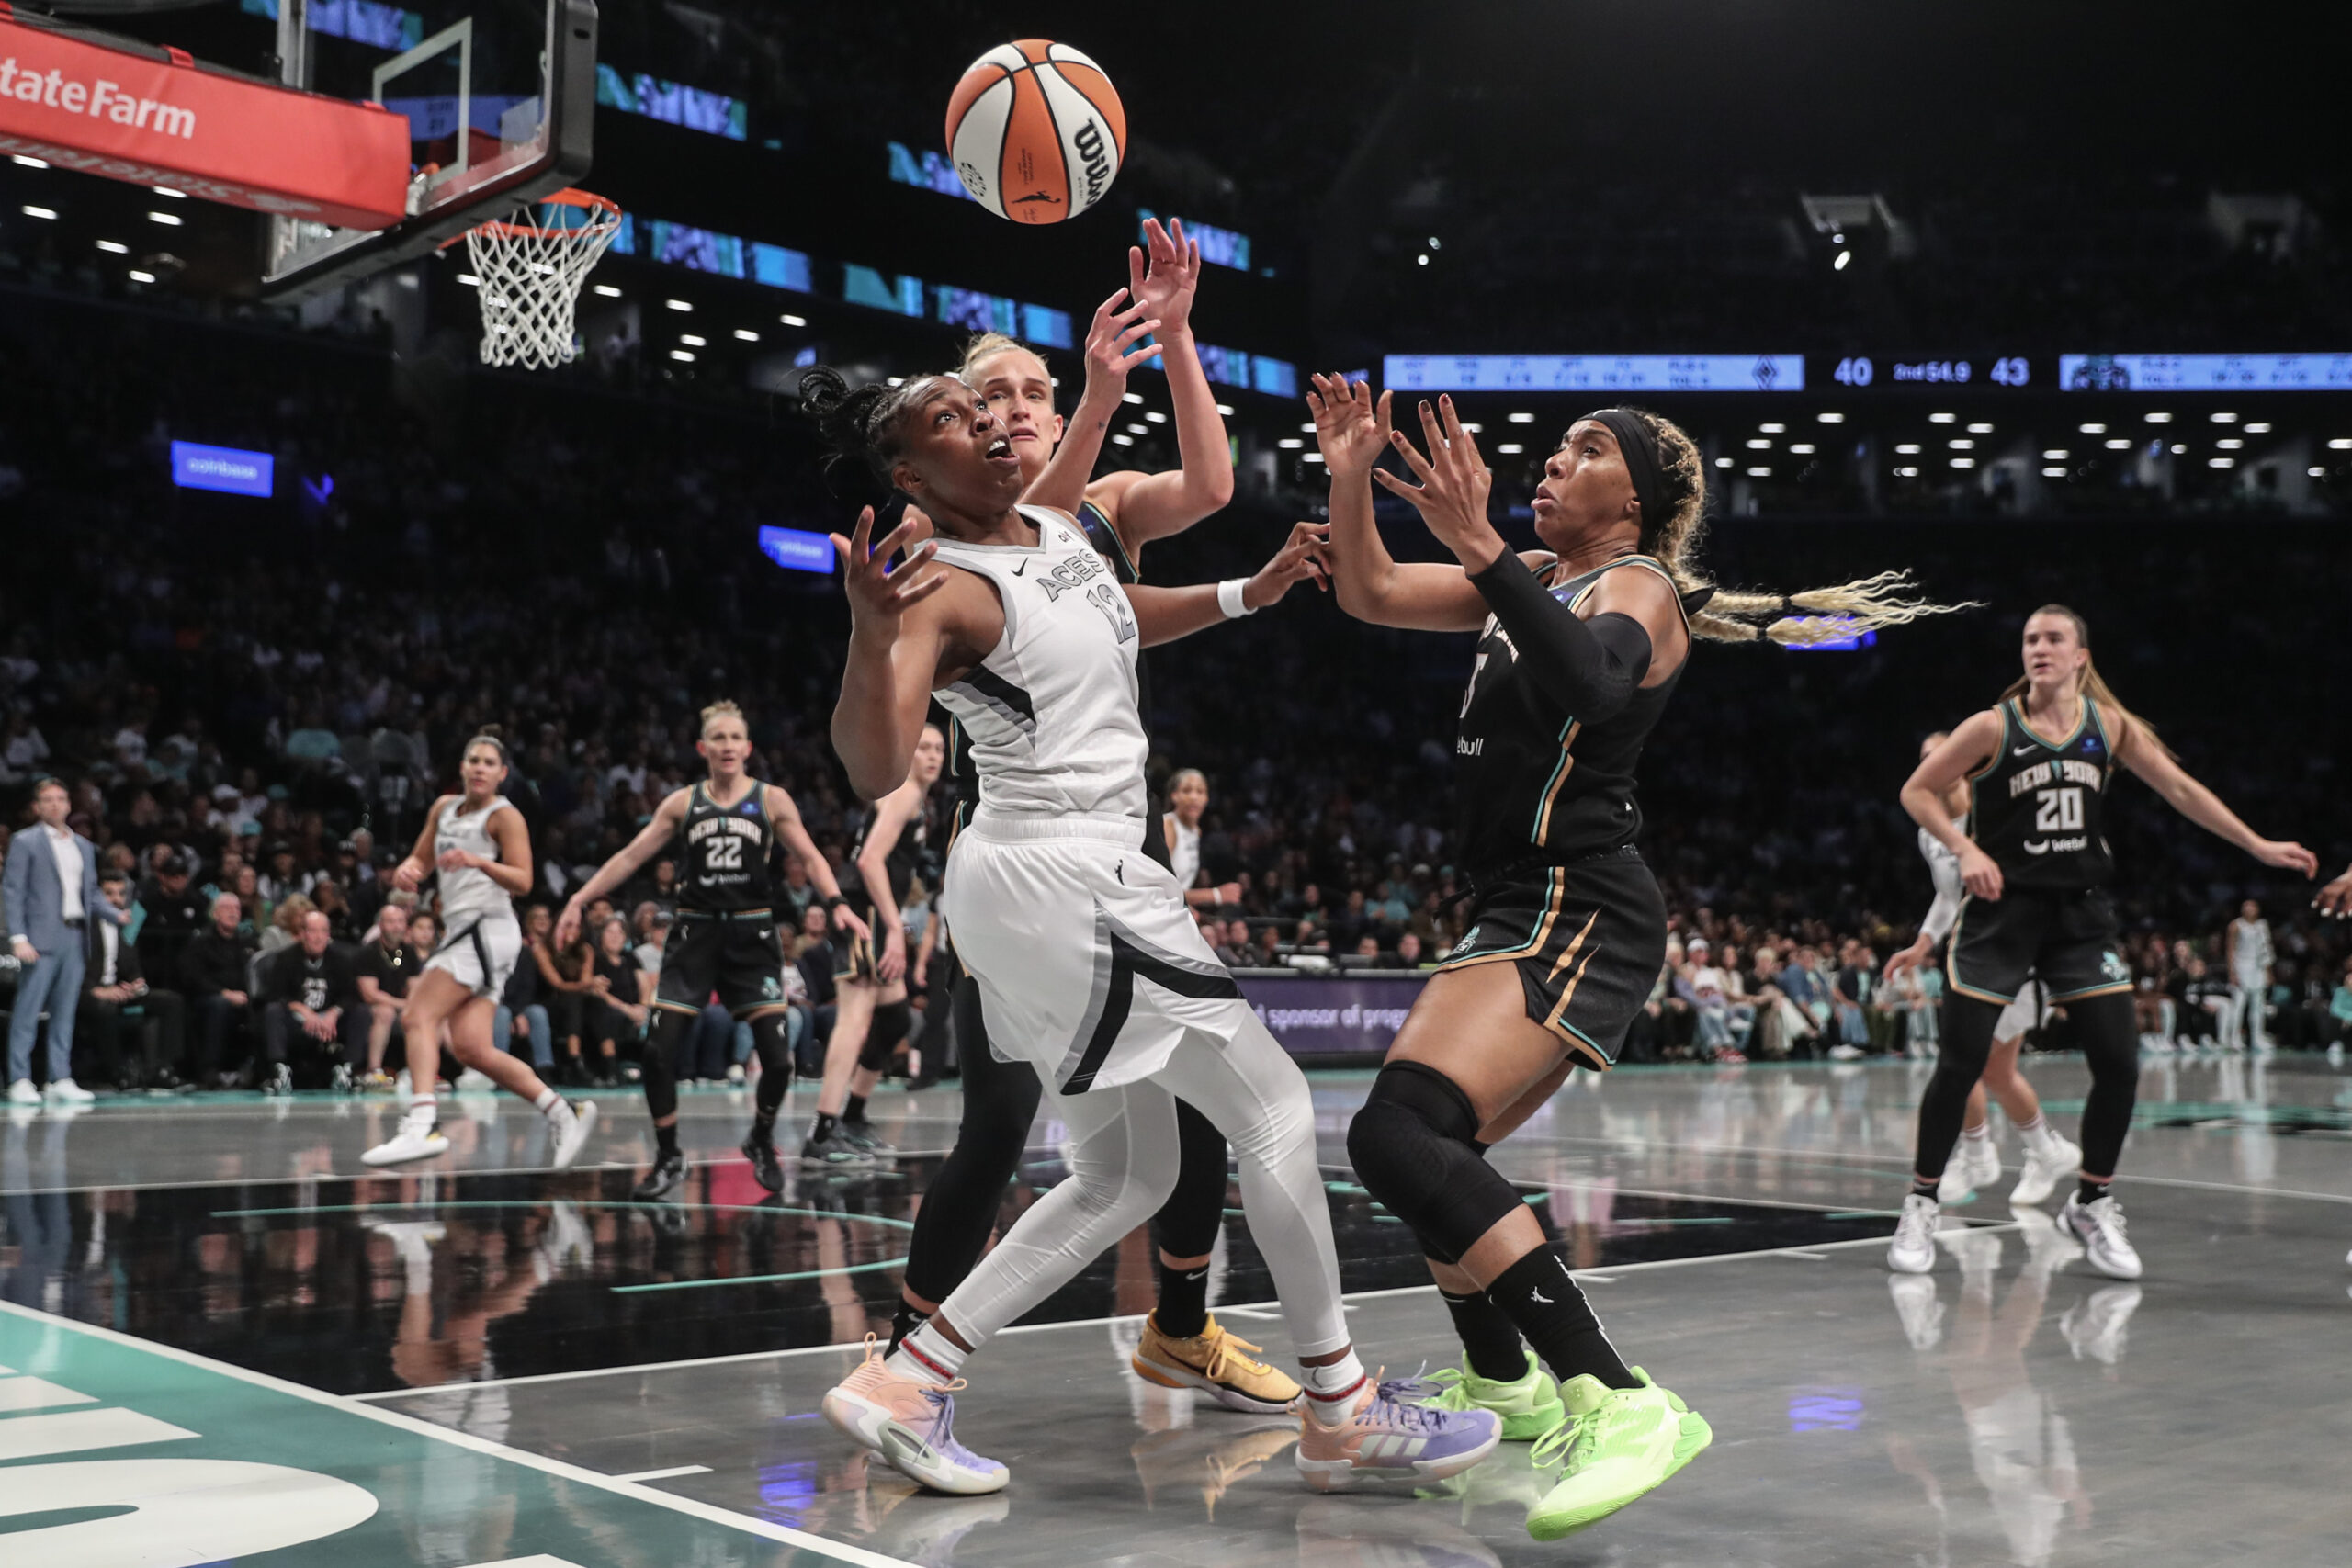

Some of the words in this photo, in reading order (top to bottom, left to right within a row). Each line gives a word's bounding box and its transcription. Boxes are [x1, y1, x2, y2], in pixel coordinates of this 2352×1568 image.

[1074, 118, 1110, 209] Wilso
[1834, 356, 1873, 386] 40
[1990, 356, 2030, 386] 43
[1036, 548, 1105, 603] ACES
[1086, 583, 1136, 645] 12
[2008, 761, 2052, 799] NEW
[2036, 787, 2085, 832] 20
[705, 836, 742, 870] 22
[1266, 1009, 1340, 1034] sponsor
[1340, 1003, 1363, 1029] of
